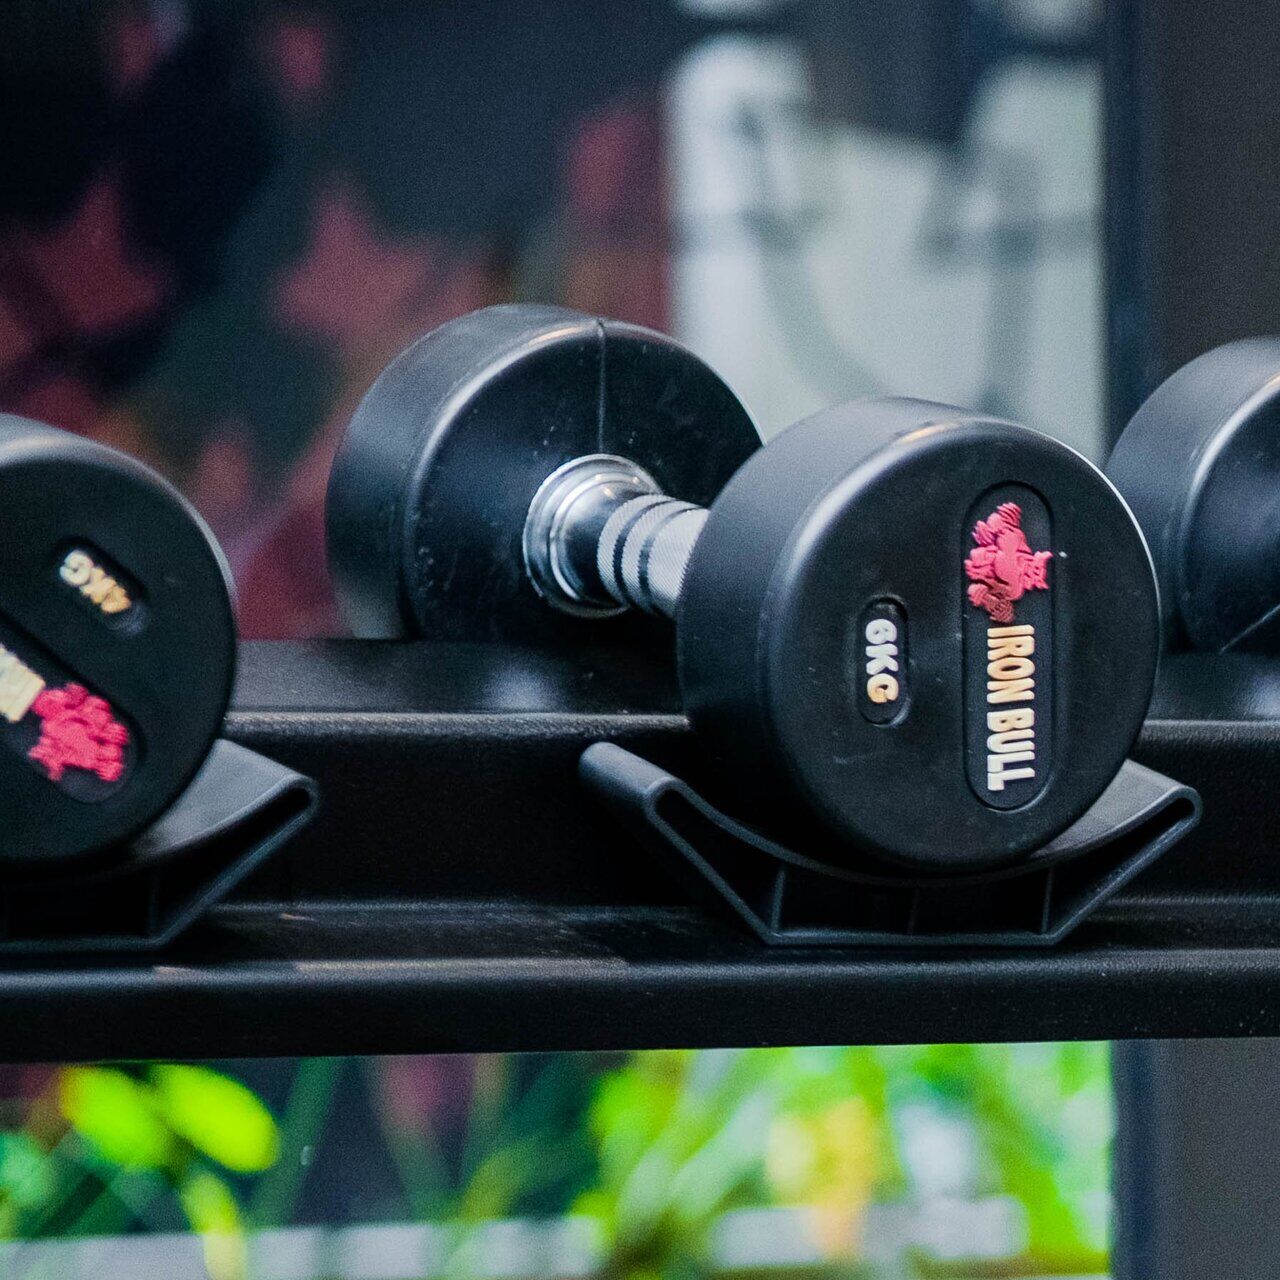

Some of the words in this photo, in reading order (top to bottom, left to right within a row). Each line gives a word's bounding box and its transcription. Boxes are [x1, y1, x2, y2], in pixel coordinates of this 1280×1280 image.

[865, 619, 899, 703] 6KG
[987, 624, 1035, 703] IRON
[987, 707, 1035, 791] BULL
